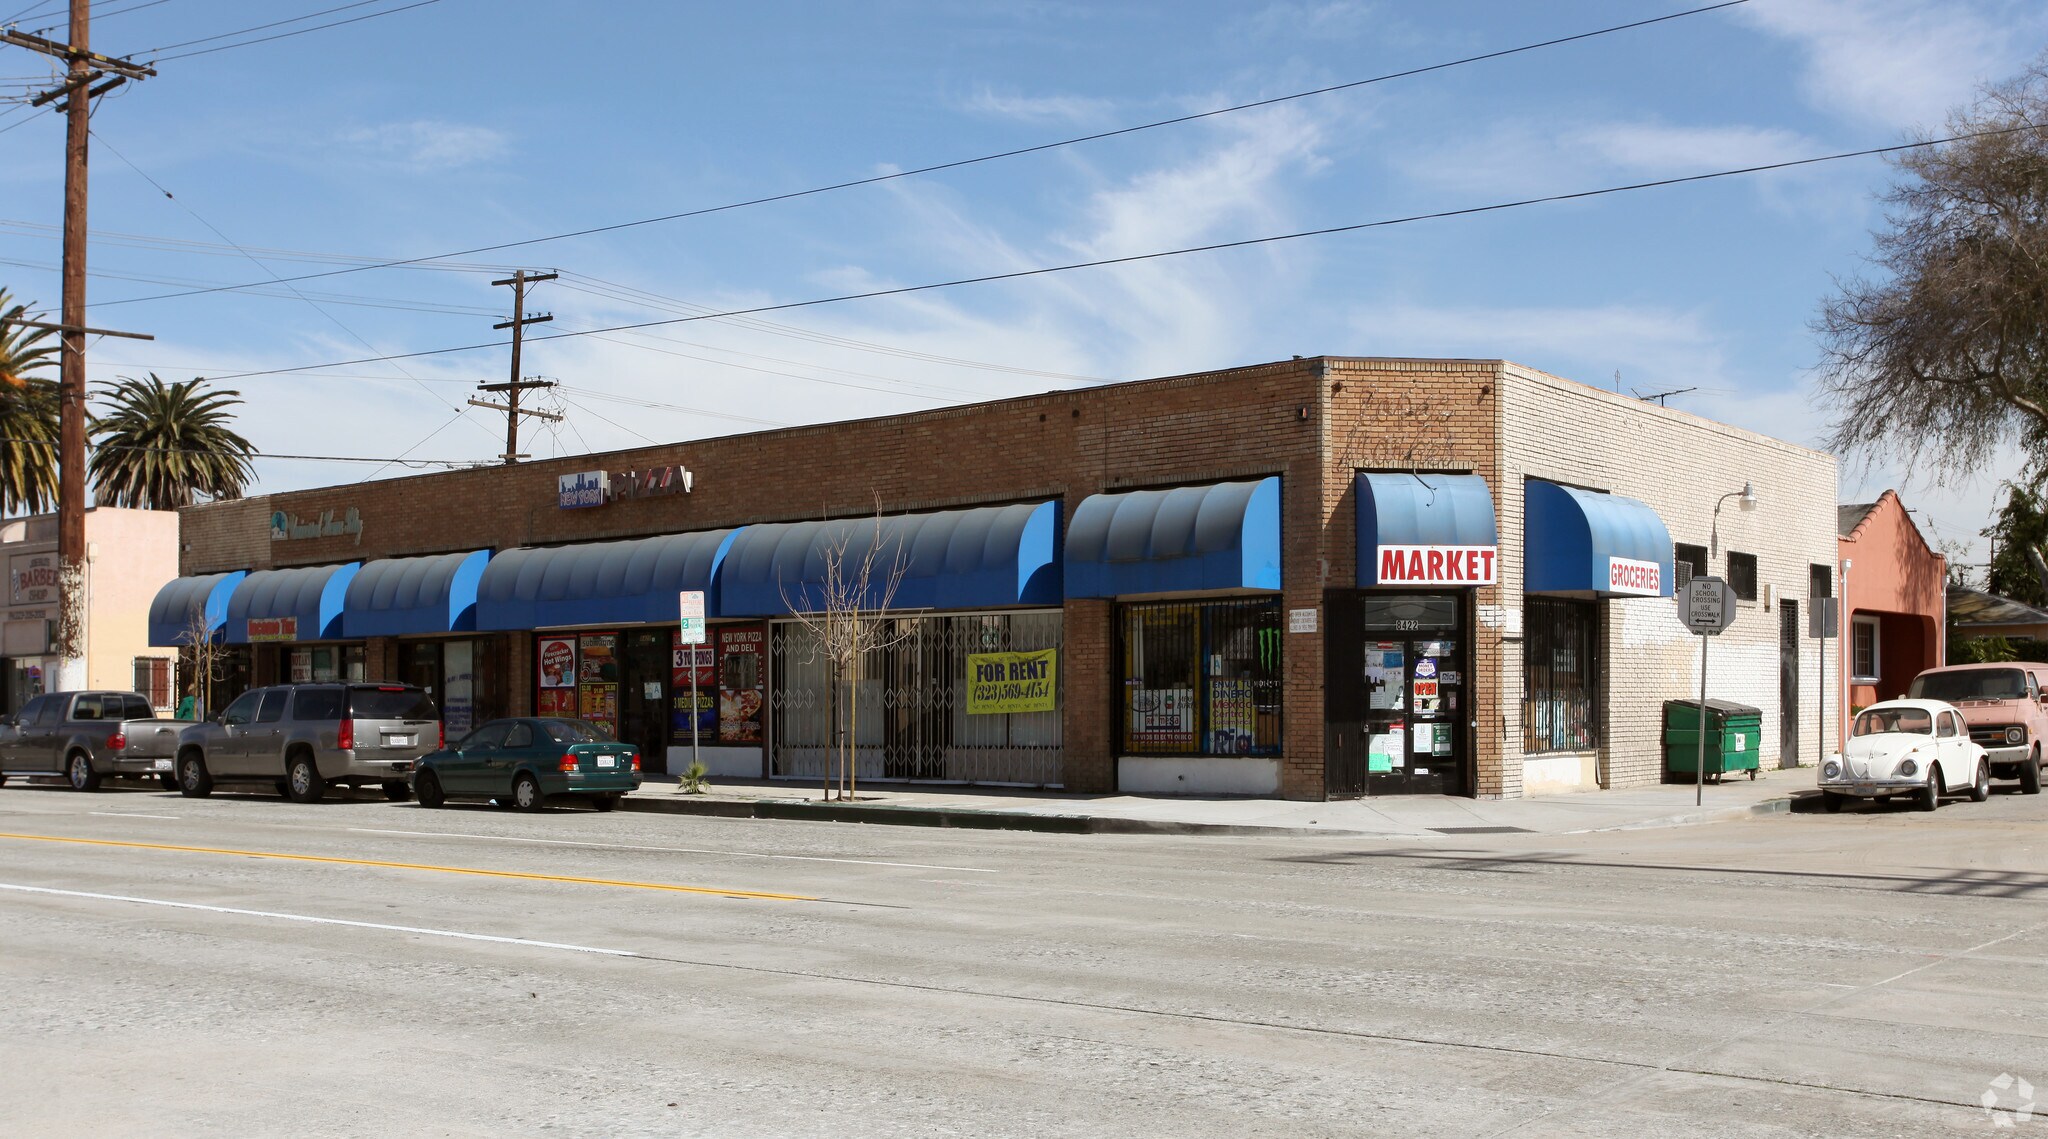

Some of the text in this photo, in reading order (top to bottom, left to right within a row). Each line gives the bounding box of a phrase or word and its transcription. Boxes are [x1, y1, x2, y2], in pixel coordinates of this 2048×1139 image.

[610, 465, 690, 500] PIZZA
[560, 488, 600, 506] NEW YORK
[1380, 550, 1494, 580] MARKET
[1611, 563, 1658, 590] GROCERIES
[29, 589, 48, 600] SHOP
[1396, 620, 1418, 630] 8422
[722, 633, 733, 642] NEW
[734, 632, 747, 642] YORK
[748, 631, 762, 642] PIZZA
[544, 648, 569, 657] Firecracker
[726, 643, 756, 652] AND DELI
[544, 654, 572, 665] Hot Wings
[676, 651, 683, 666] 3
[976, 660, 1048, 682] FOR RENT
[1442, 672, 1454, 680] Ria
[1213, 680, 1238, 689] ENVIA
[1415, 682, 1437, 695] OPEN
[1213, 690, 1252, 698] DINERO
[1213, 698, 1252, 708] México
[1213, 710, 1243, 718] Centro
